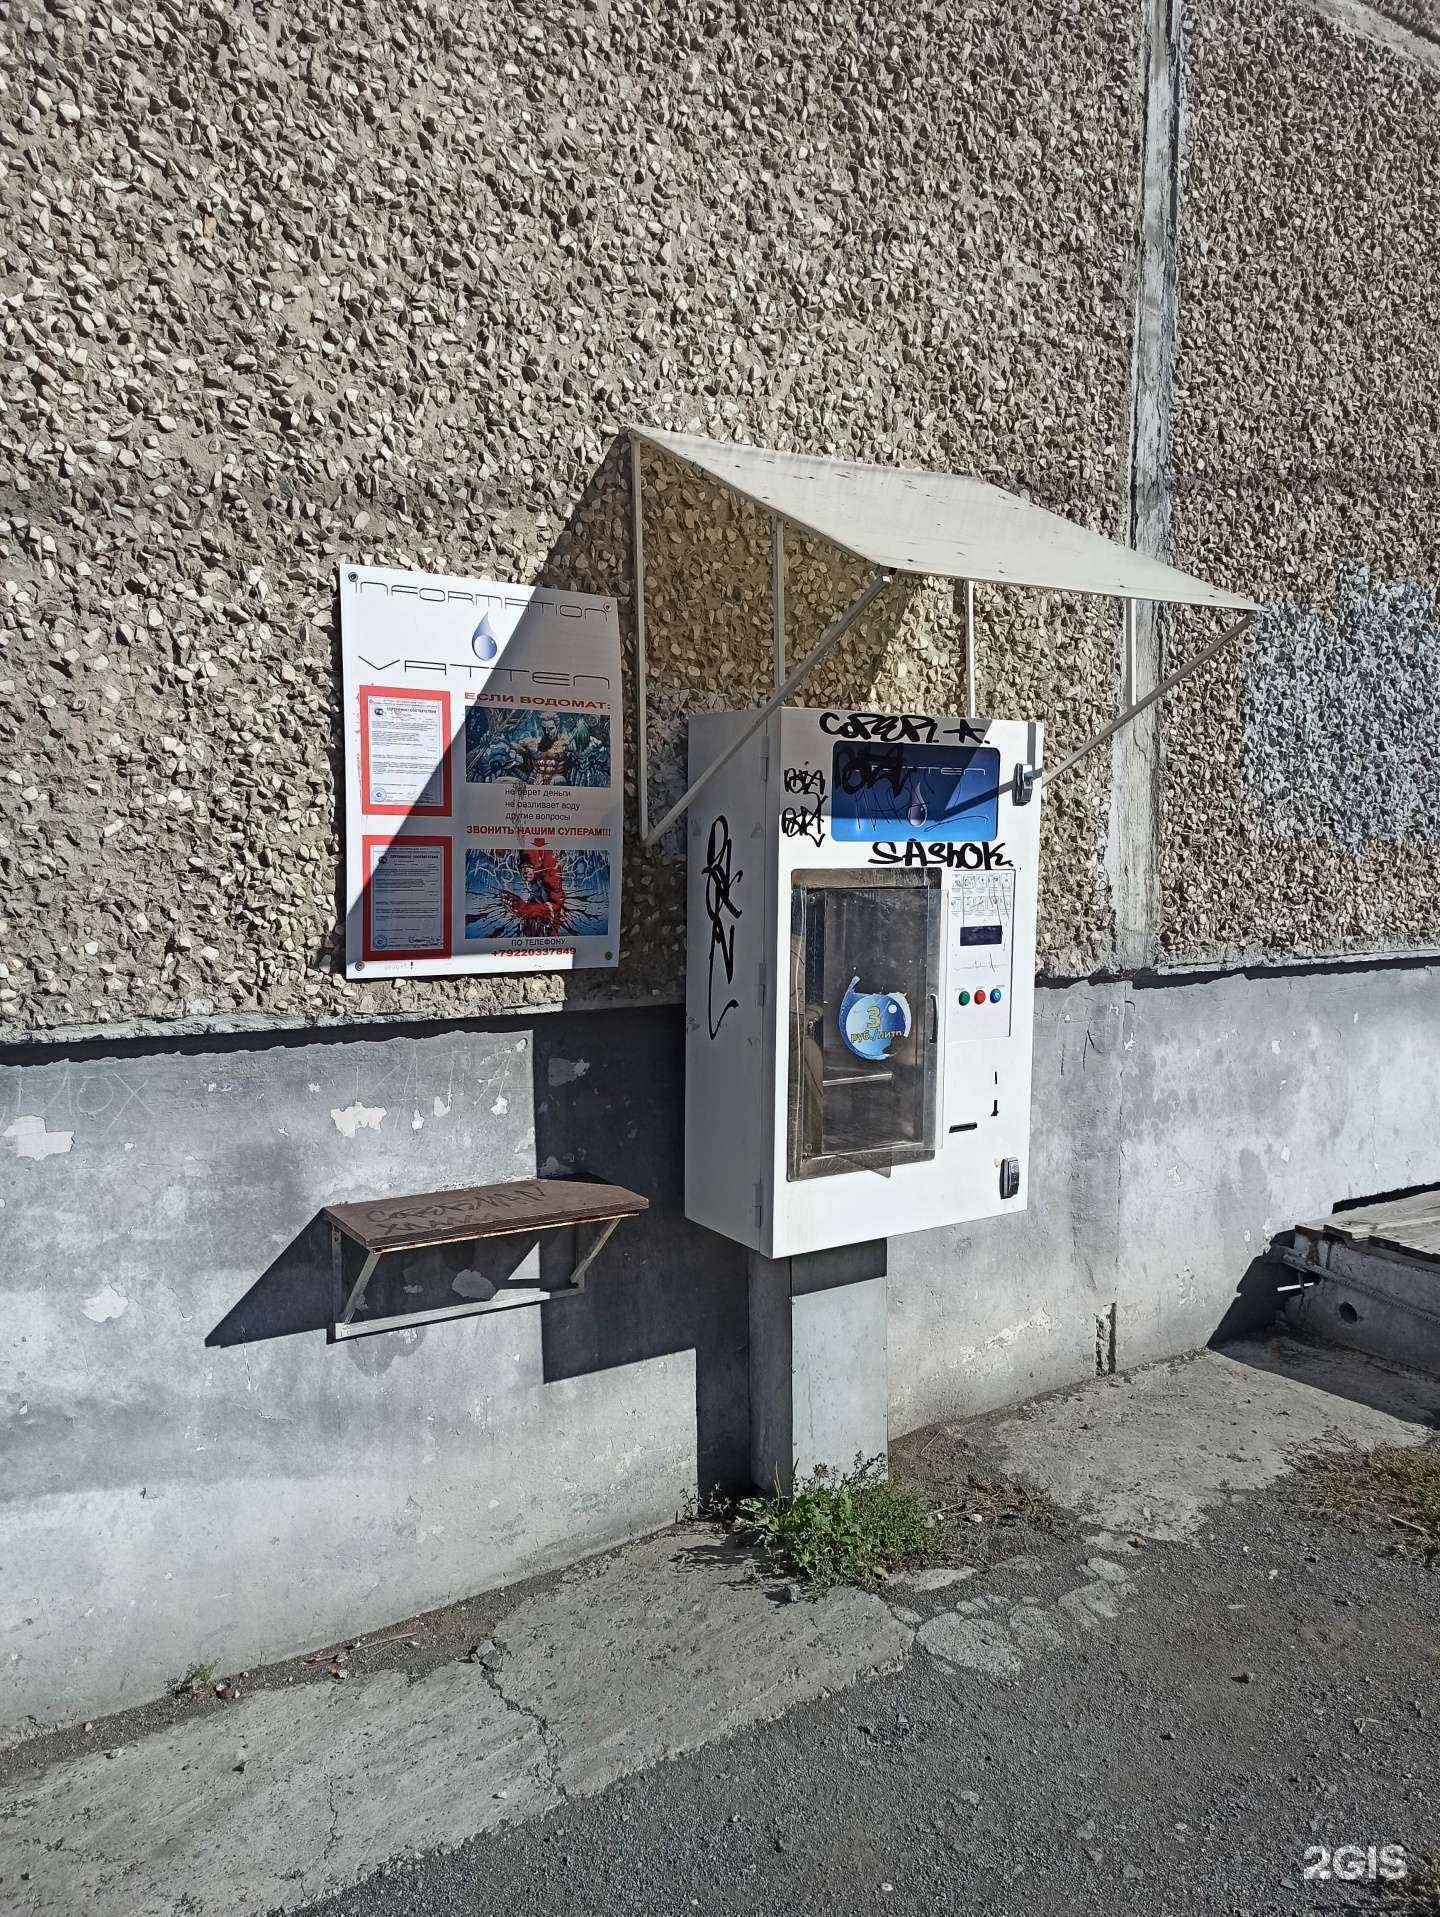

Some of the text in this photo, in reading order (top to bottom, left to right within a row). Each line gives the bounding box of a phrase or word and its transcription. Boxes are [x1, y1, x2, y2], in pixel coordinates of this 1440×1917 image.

[464, 691, 611, 710] ЕСЛИ ВОДОМАТ:
[543, 789, 571, 797] деньги
[517, 801, 560, 811] разливает
[561, 803, 581, 811] воду
[466, 825, 515, 835] ЗВОНИТЬ
[517, 826, 556, 836] НАШИМ
[867, 1005, 881, 1028] 3
